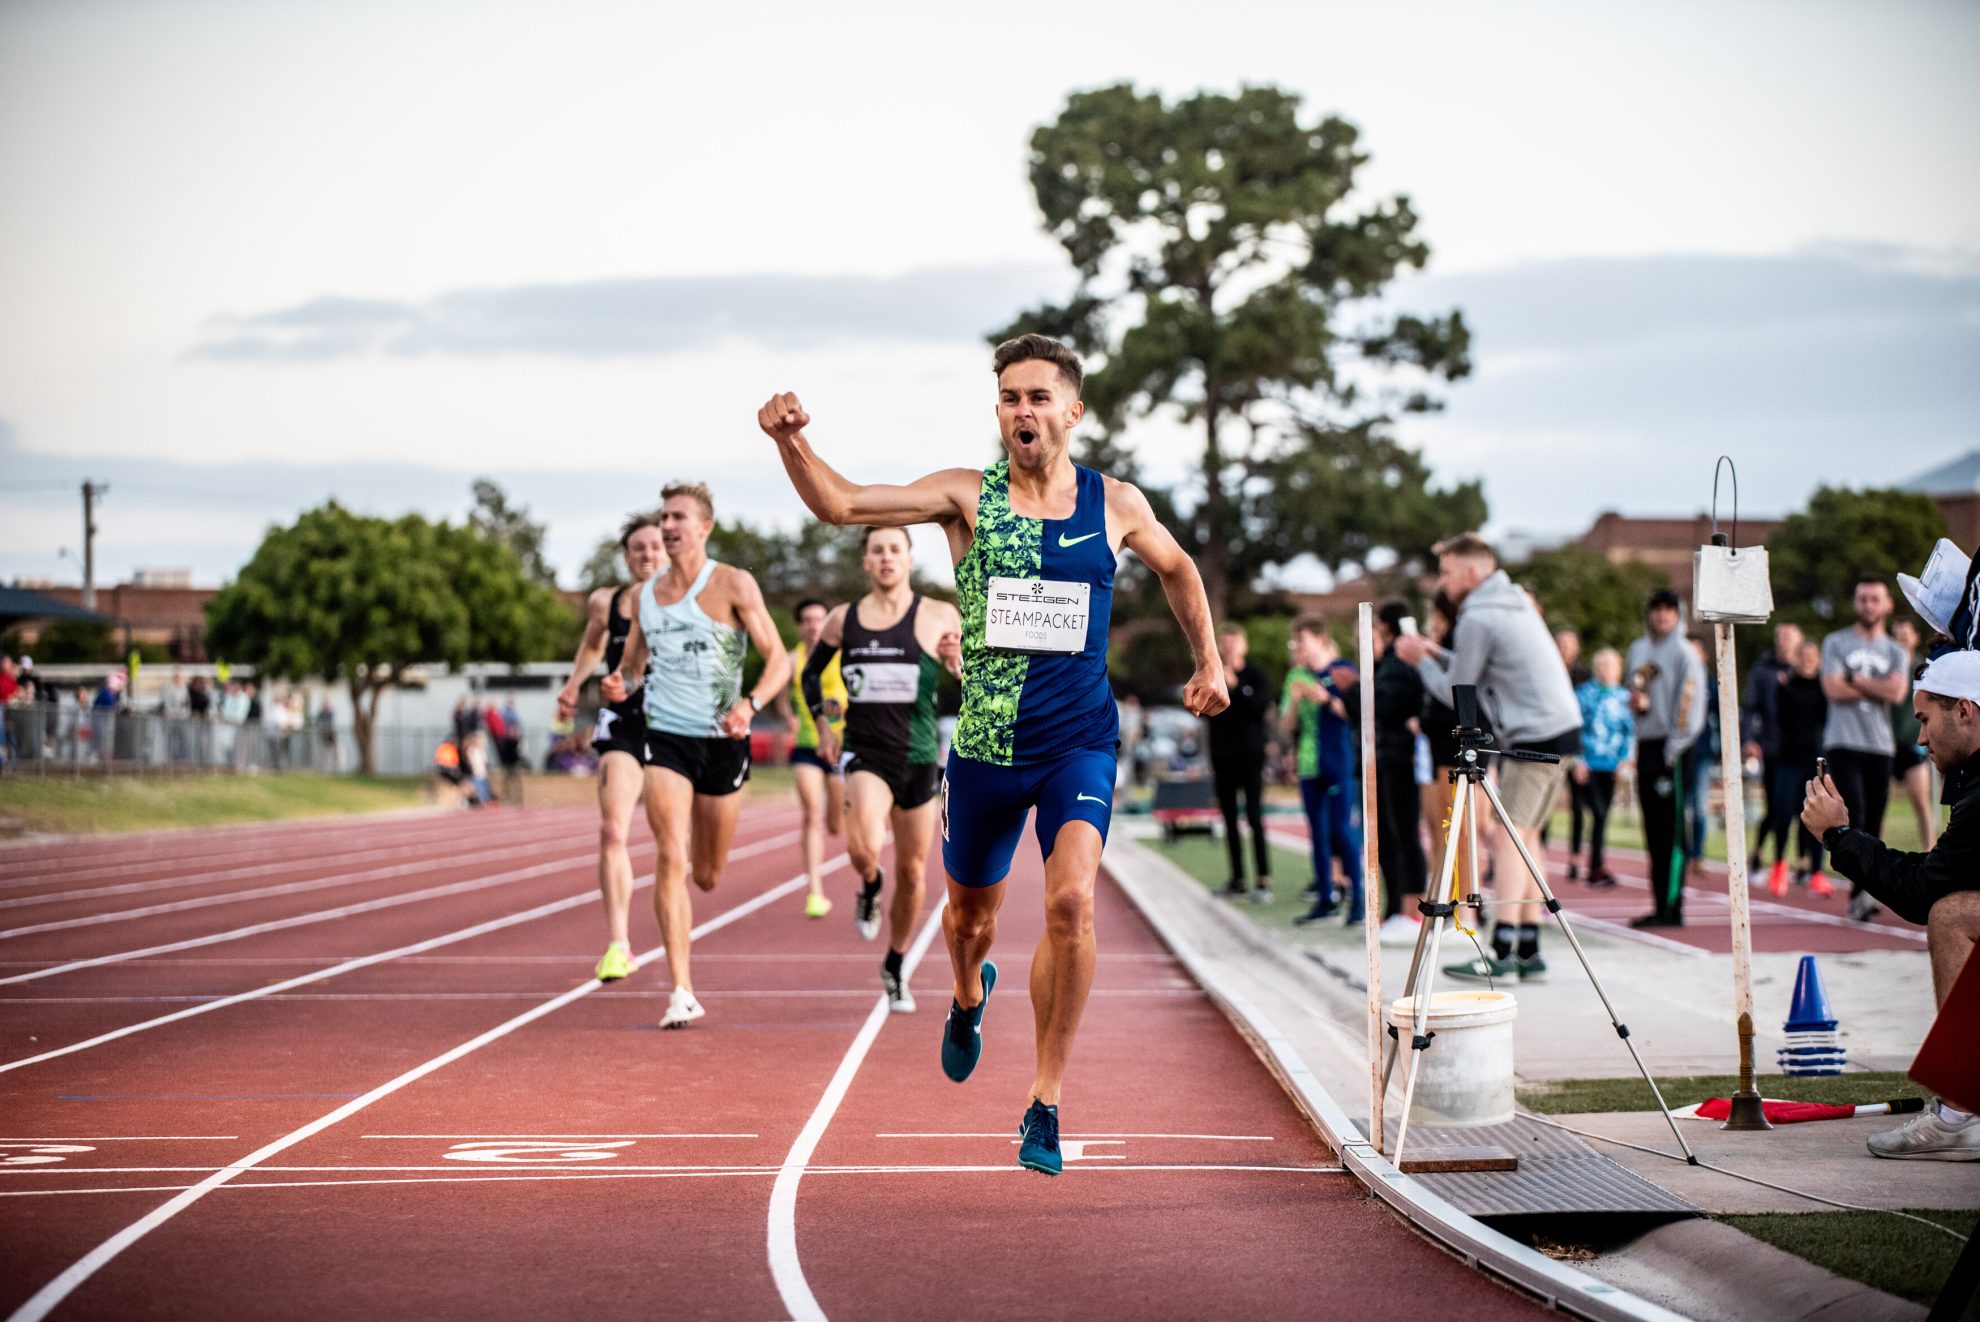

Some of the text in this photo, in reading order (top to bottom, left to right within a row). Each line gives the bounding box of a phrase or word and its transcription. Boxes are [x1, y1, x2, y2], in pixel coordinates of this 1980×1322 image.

[996, 592, 1079, 605] STEIGEN
[990, 608, 1087, 630] STEAMPACKET
[1025, 630, 1048, 640] FOODS
